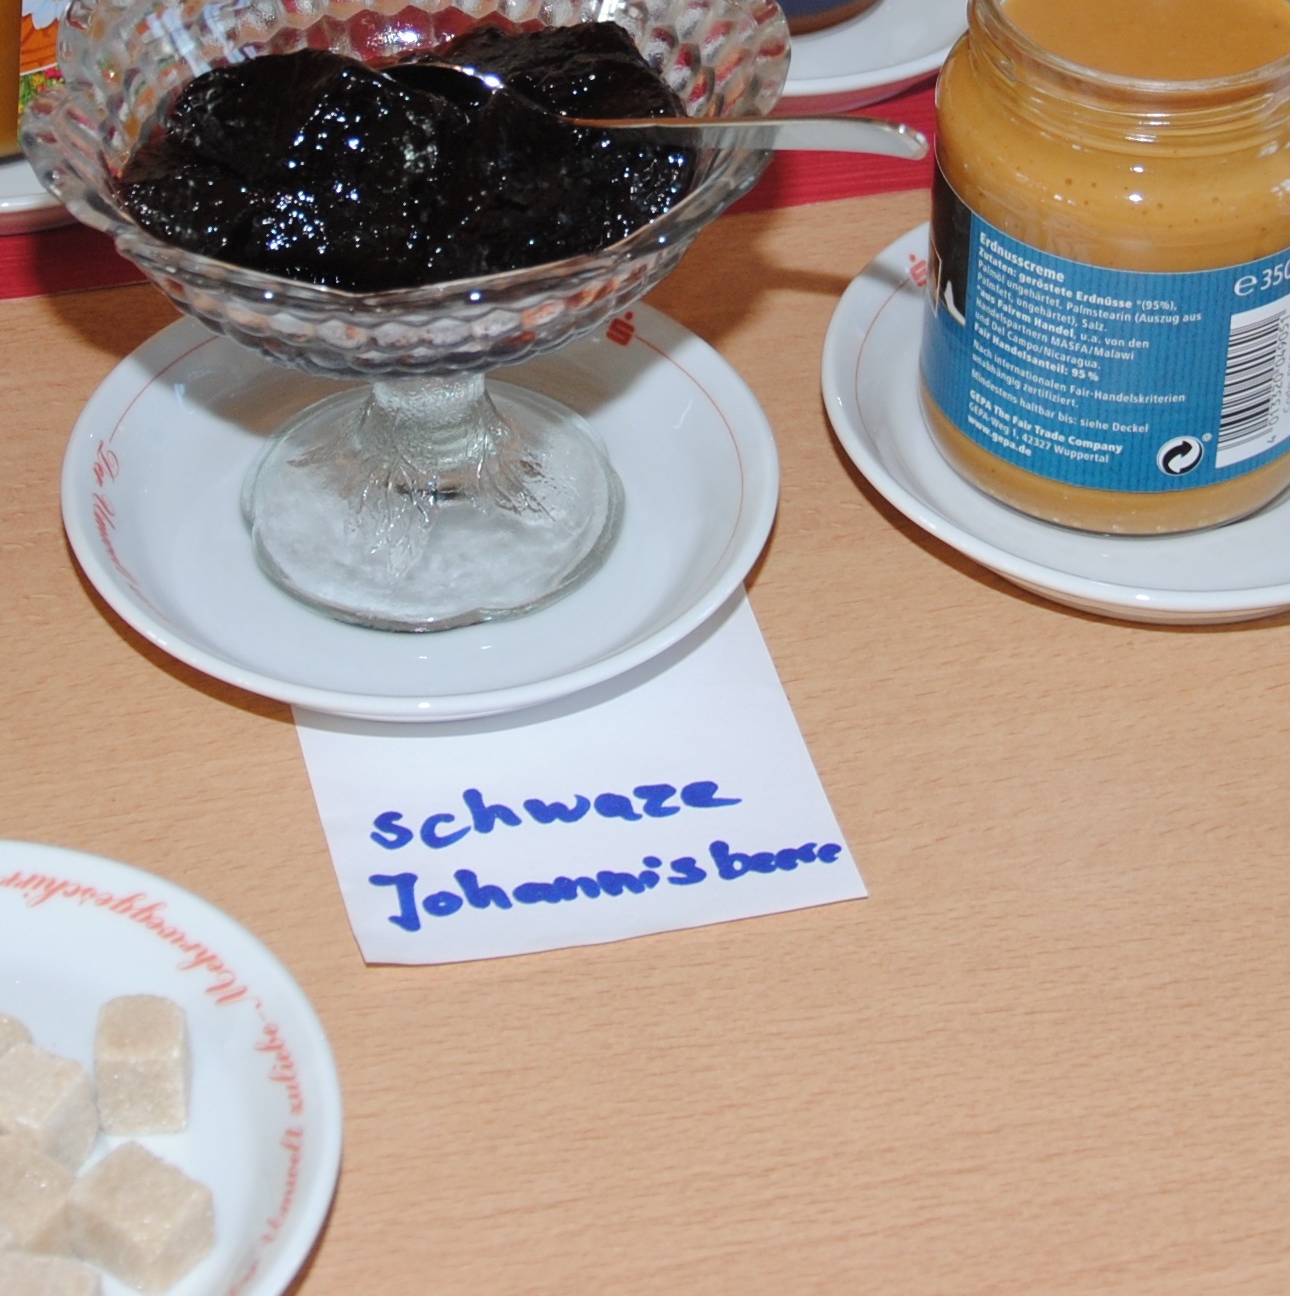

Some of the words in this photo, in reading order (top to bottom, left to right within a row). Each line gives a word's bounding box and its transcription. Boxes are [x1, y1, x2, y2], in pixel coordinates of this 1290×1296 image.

[978, 247, 1018, 278] Zutaten:
[1018, 271, 1074, 300] geröstete
[1076, 290, 1133, 310] Erdnüsse
[979, 230, 1066, 284] Erdnusscreme
[977, 259, 1006, 284] Palmöl
[1006, 277, 1064, 311] ungehärtet,
[1066, 302, 1133, 323] Palmstearin
[1134, 310, 1181, 326] (Auszug
[1182, 312, 1203, 323] aus
[977, 272, 1015, 303] Palmfett,
[1016, 296, 1079, 327] ungehärtet),
[1081, 319, 1109, 333] Salz.
[974, 310, 991, 327] und
[991, 320, 1007, 336] Del
[1007, 329, 1102, 371] Campo/Nicaragua.
[974, 322, 992, 341] Fair
[992, 335, 1069, 376] Handelsanteil:
[1070, 368, 1086, 380] 95
[1085, 370, 1100, 382] %
[975, 296, 1049, 343] Handelspartnern
[1050, 335, 1135, 361] MASFA/Malawi
[997, 299, 1033, 324] Fairem
[1033, 315, 1079, 341] Handel,
[1080, 332, 1103, 345] u.a.
[1104, 336, 1126, 348] von
[1127, 337, 1150, 349] den
[1273, 313, 1290, 369] 049051
[971, 354, 1022, 391] unabhängig
[1022, 383, 1080, 409] zertifiziert.
[971, 368, 1019, 407] Mindestens
[1019, 397, 1056, 421] haltbar
[1057, 410, 1078, 426] bis:
[1079, 417, 1110, 431] siehe
[1111, 421, 1150, 434] Deckel
[973, 339, 993, 359] Nach
[993, 351, 1068, 394] internationalen
[1069, 385, 1187, 405] Fair-Handelskriterien
[1268, 372, 1285, 426] 013320
[966, 413, 1033, 458] www.gepa.de
[967, 402, 1010, 437] GEPA-Weg
[1020, 432, 1053, 451] 42327
[1053, 444, 1111, 465] Wuppertal
[969, 388, 993, 412] GEPA
[993, 404, 1011, 423] The
[1011, 413, 1033, 432] Fair
[1034, 424, 1066, 444] Trade
[1067, 435, 1125, 456] Company
